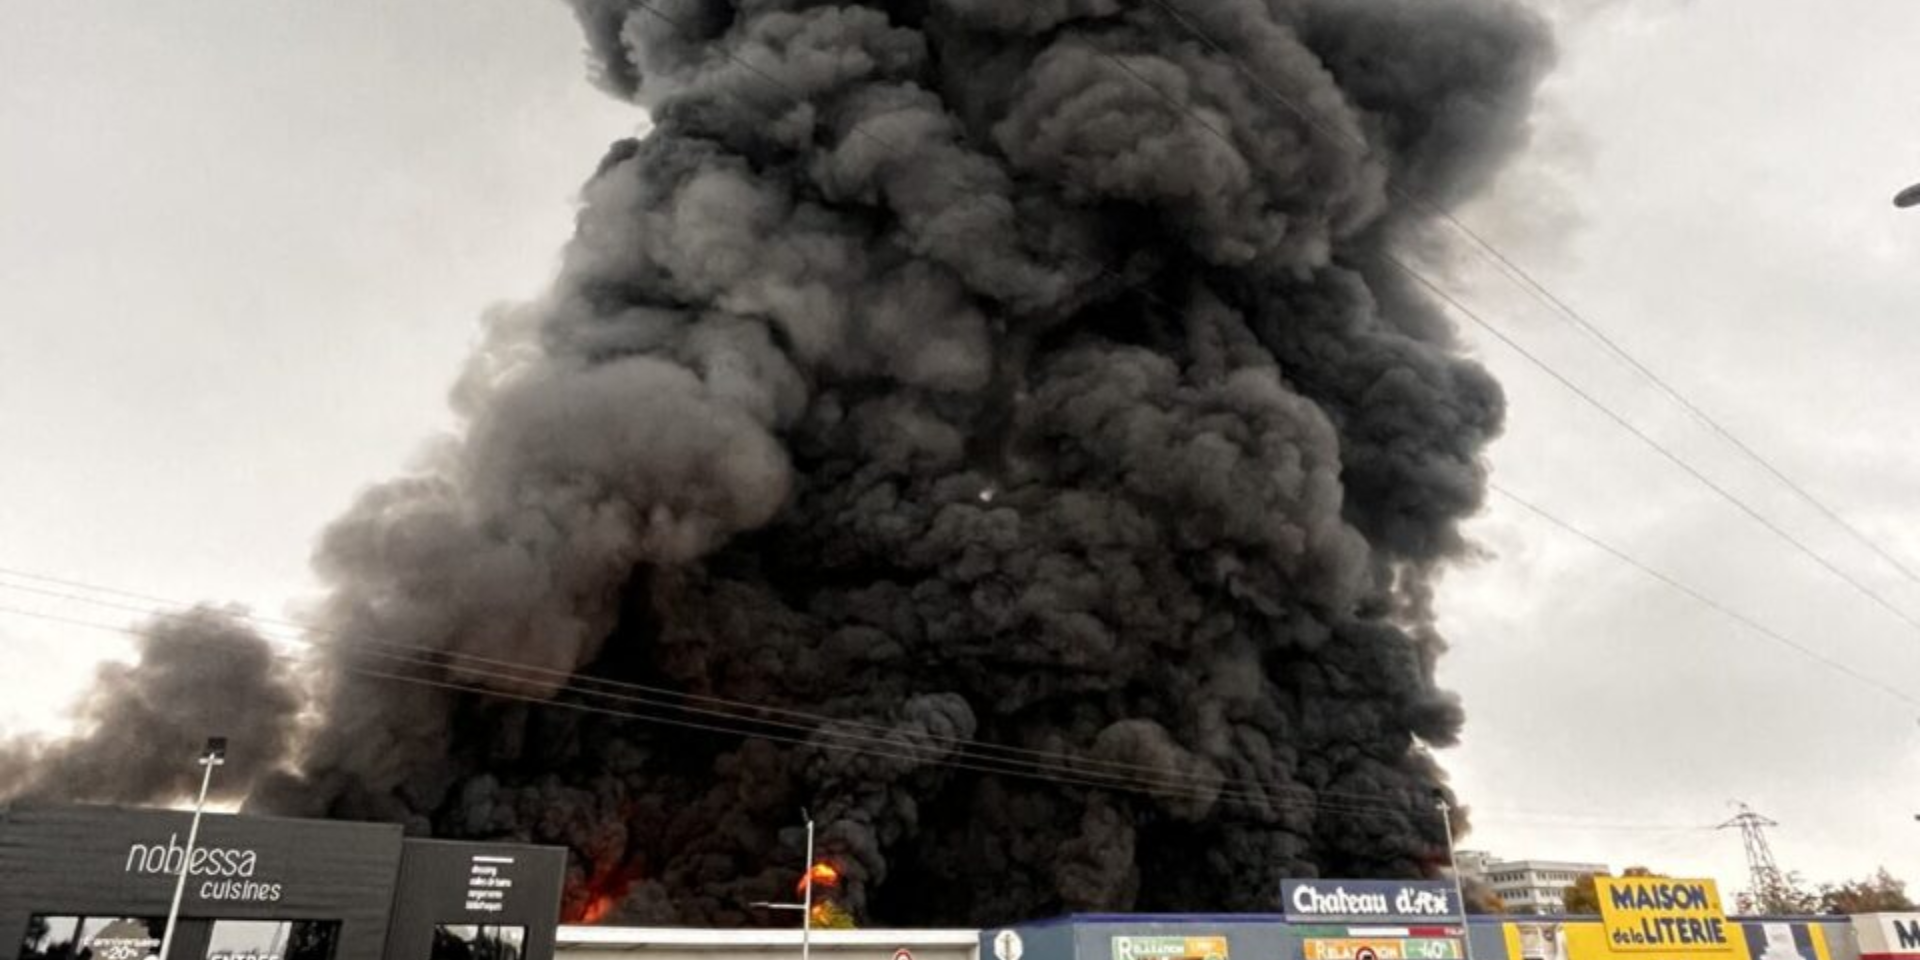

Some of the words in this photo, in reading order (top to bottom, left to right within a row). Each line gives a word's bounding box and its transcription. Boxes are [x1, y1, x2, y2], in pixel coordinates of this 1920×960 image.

[126, 832, 257, 877] nobessa
[200, 880, 282, 901] cuisines
[1293, 884, 1388, 914] Chateau
[1609, 884, 1708, 910] MAISON
[1641, 917, 1727, 943] LITERIE
